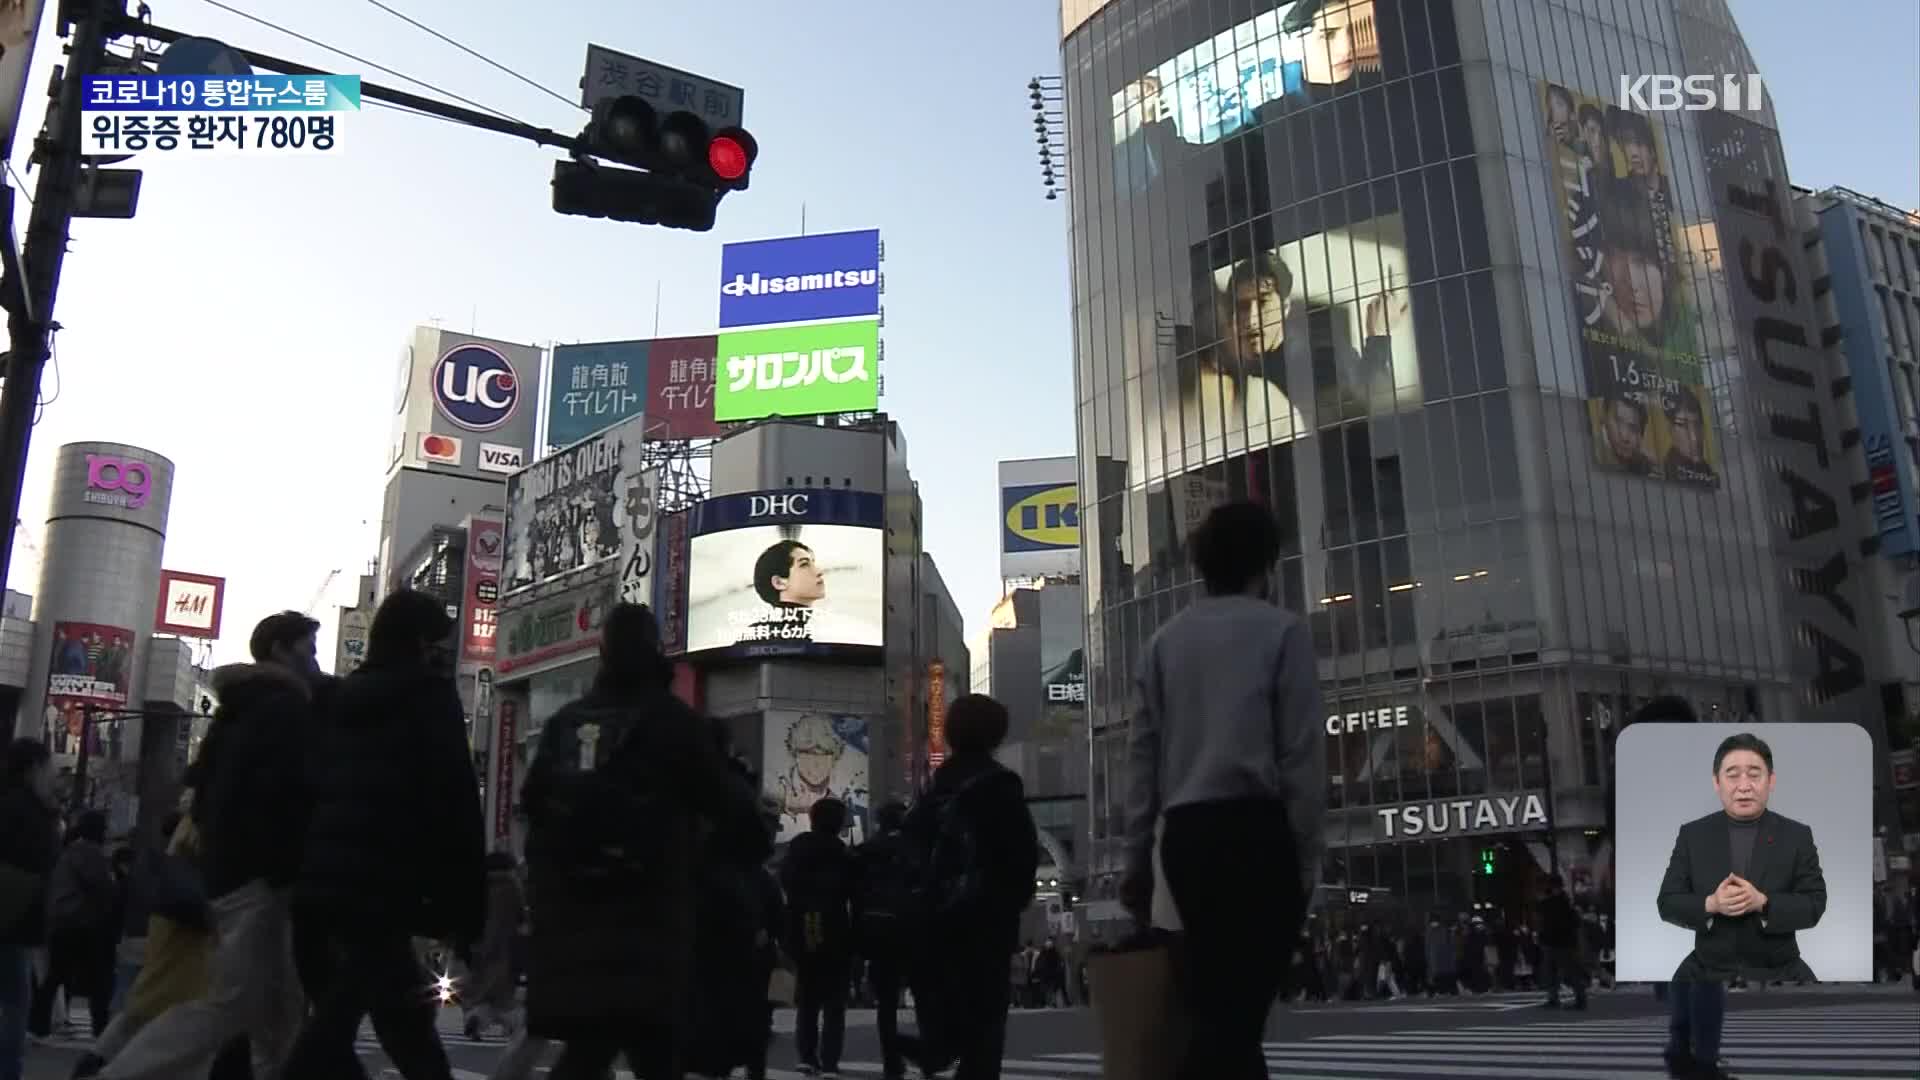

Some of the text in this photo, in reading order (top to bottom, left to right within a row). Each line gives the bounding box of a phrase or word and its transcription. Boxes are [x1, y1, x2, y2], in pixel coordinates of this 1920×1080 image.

[600, 57, 730, 118] 渋谷駅前
[721, 268, 877, 297] Hisamitsu
[570, 360, 630, 390] 龍角散
[725, 345, 870, 393] サロンパス
[1641, 373, 1682, 395] START
[562, 389, 638, 417] ダイレクト
[1726, 176, 1867, 704] TSUTAYA
[483, 448, 521, 468] VISA
[85, 454, 153, 509] 109
[750, 493, 809, 517] DHC
[1378, 794, 1548, 837] TSUTAYA
